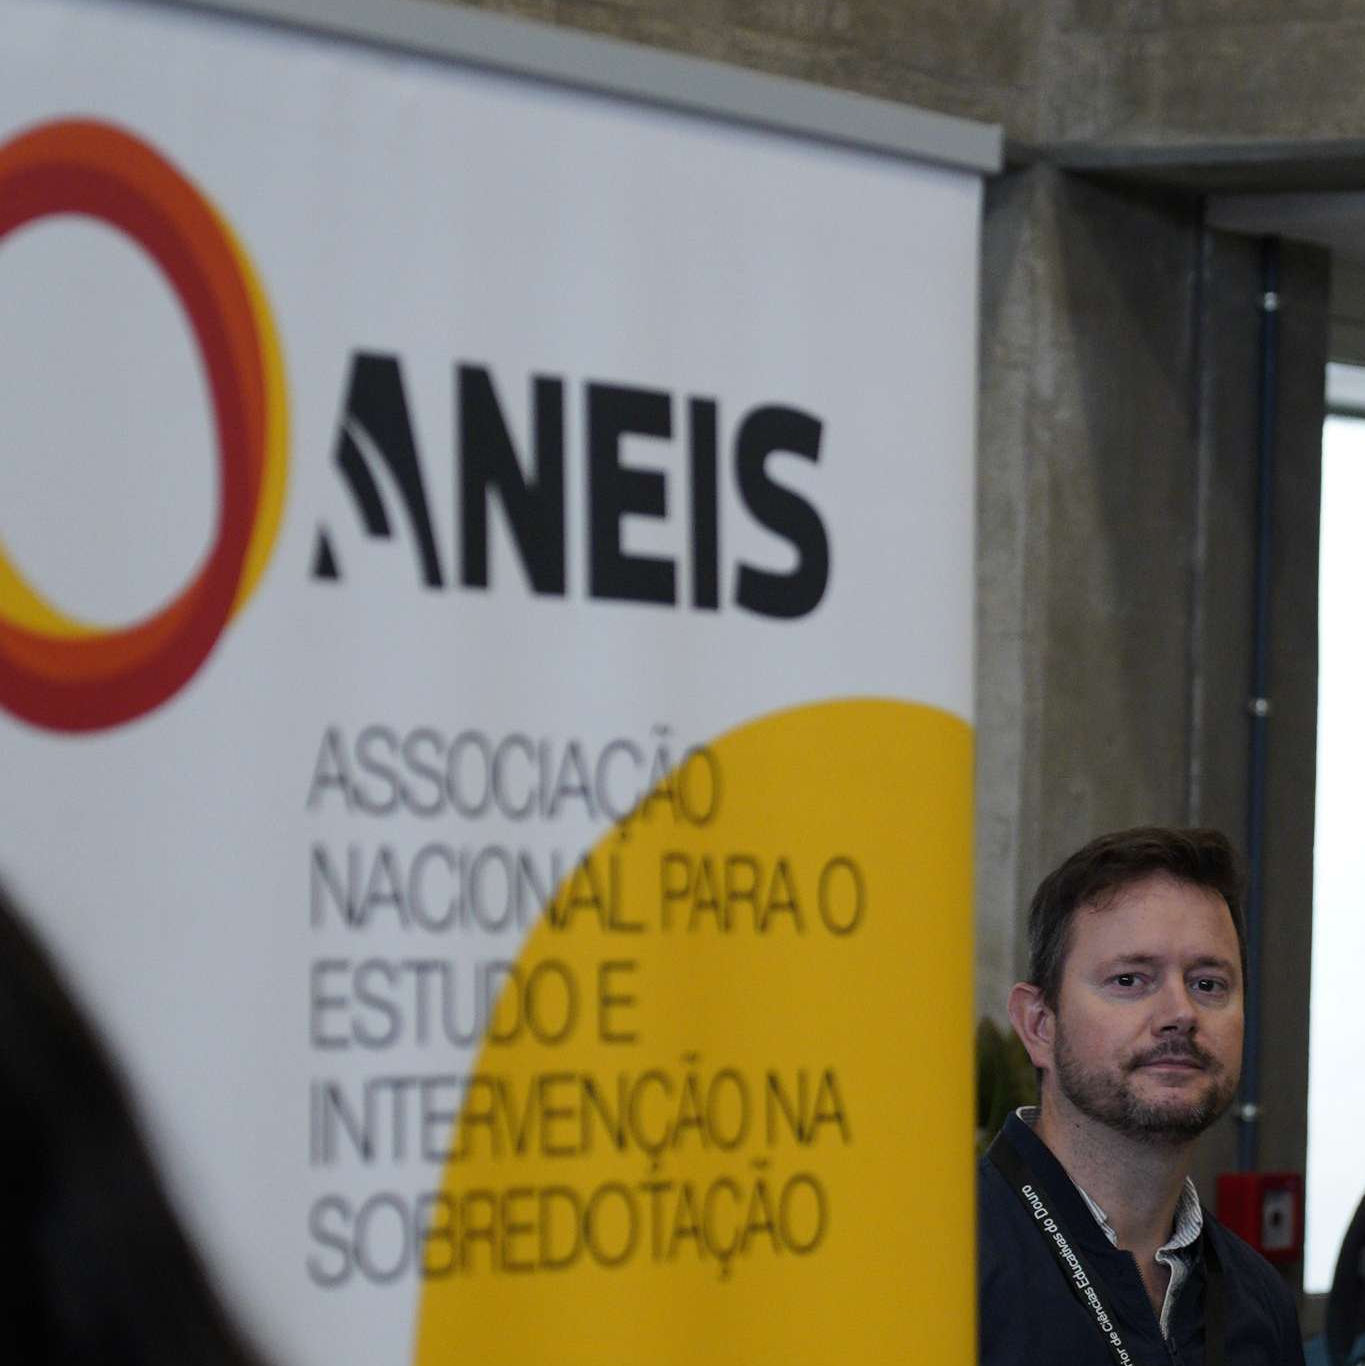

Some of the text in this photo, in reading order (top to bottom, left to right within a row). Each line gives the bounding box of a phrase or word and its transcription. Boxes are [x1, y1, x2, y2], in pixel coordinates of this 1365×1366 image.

[311, 346, 832, 622] ANEIS
[305, 725, 722, 841] ASSOCIAÇÃO
[310, 843, 866, 936] NACIONAL PARA O
[310, 958, 639, 1050] ESTUDO E
[310, 1053, 853, 1173] INTERVENÇÃO NA
[306, 1159, 829, 1288] SOBREDOTAÇÃO
[1022, 1185, 1049, 1219] Douro
[1043, 1218, 1058, 1233] do
[1053, 1232, 1090, 1289] Educativas
[1084, 1286, 1113, 1333] Ciências
[1109, 1331, 1122, 1347] de
